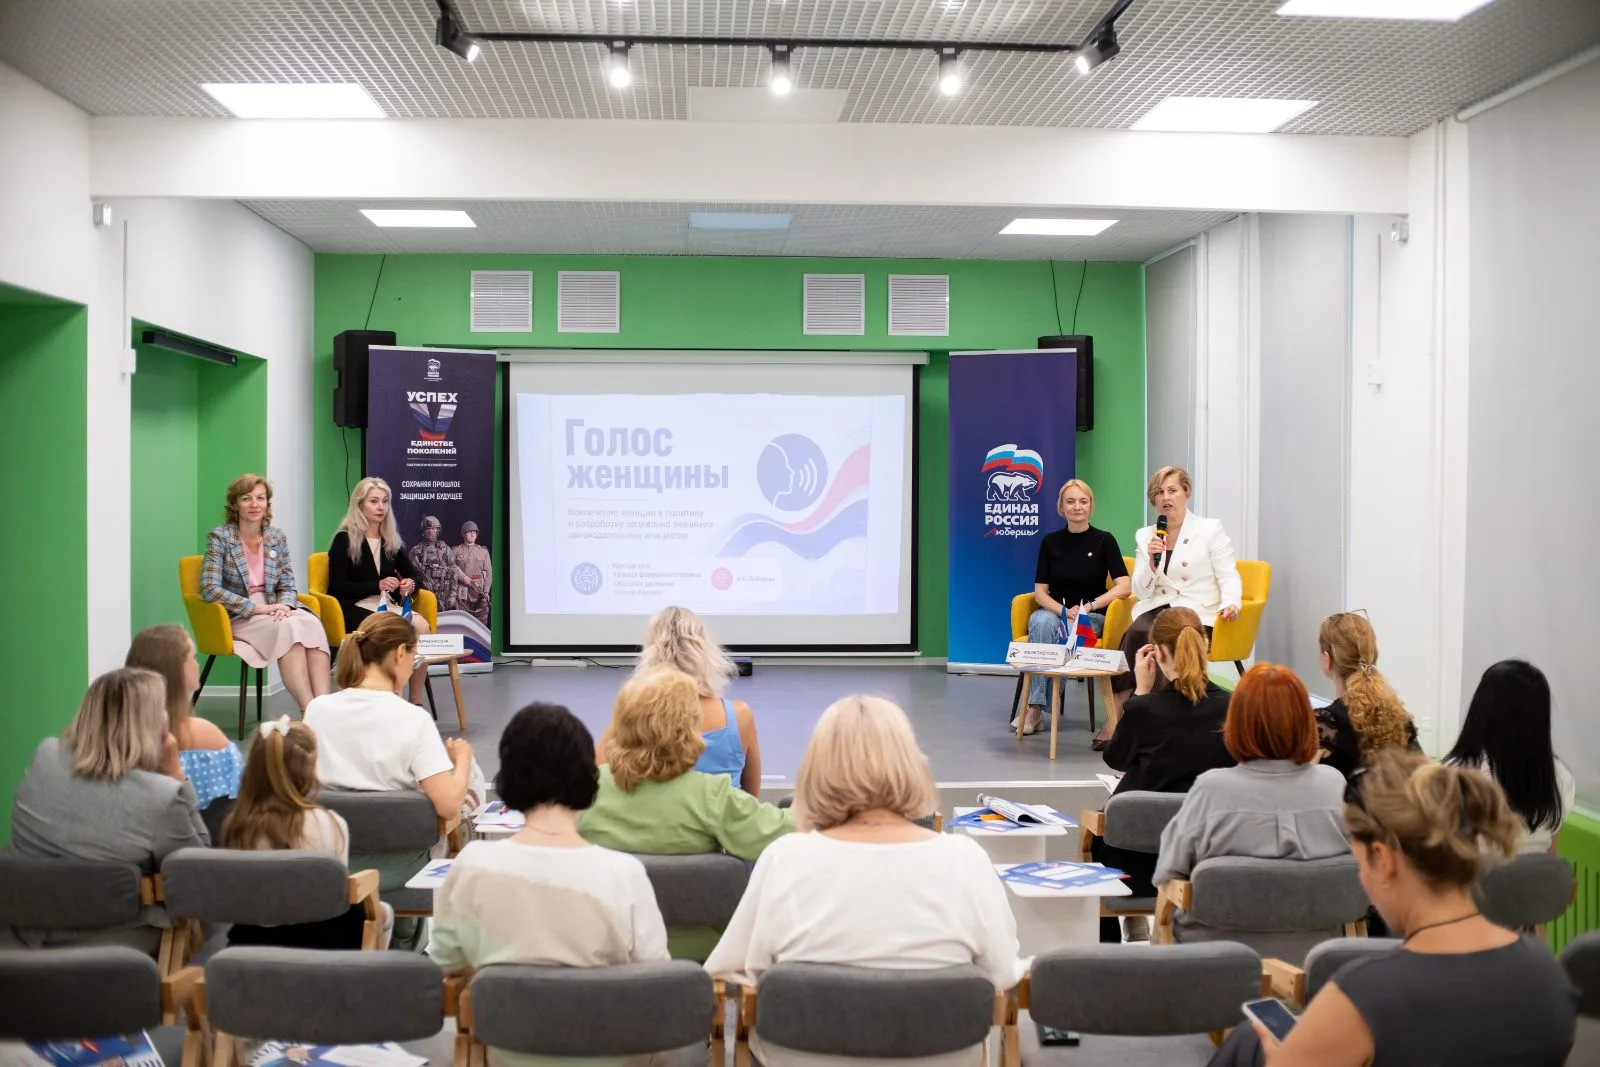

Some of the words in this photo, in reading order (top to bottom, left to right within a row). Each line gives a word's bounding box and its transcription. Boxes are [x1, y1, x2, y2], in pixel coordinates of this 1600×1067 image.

[406, 391, 458, 403] УСПЕХ
[565, 418, 674, 457] Голос
[406, 447, 457, 455] ПОКОЛЕНИЙ
[401, 480, 432, 488] СОХРАНЯЯ
[432, 480, 461, 488] ПРОШЛОЕ
[566, 464, 729, 494] женщины
[399, 492, 436, 501] ЗАЩИЩАЕМ
[436, 492, 463, 501] БУДУЩЕЕ
[621, 508, 656, 518] женщин
[665, 509, 704, 518] политику
[984, 503, 1039, 515] ЕДИНАЯ
[575, 519, 625, 529] разработку
[984, 515, 1039, 526] РОССИЯ
[983, 526, 1039, 539] Люберцы
